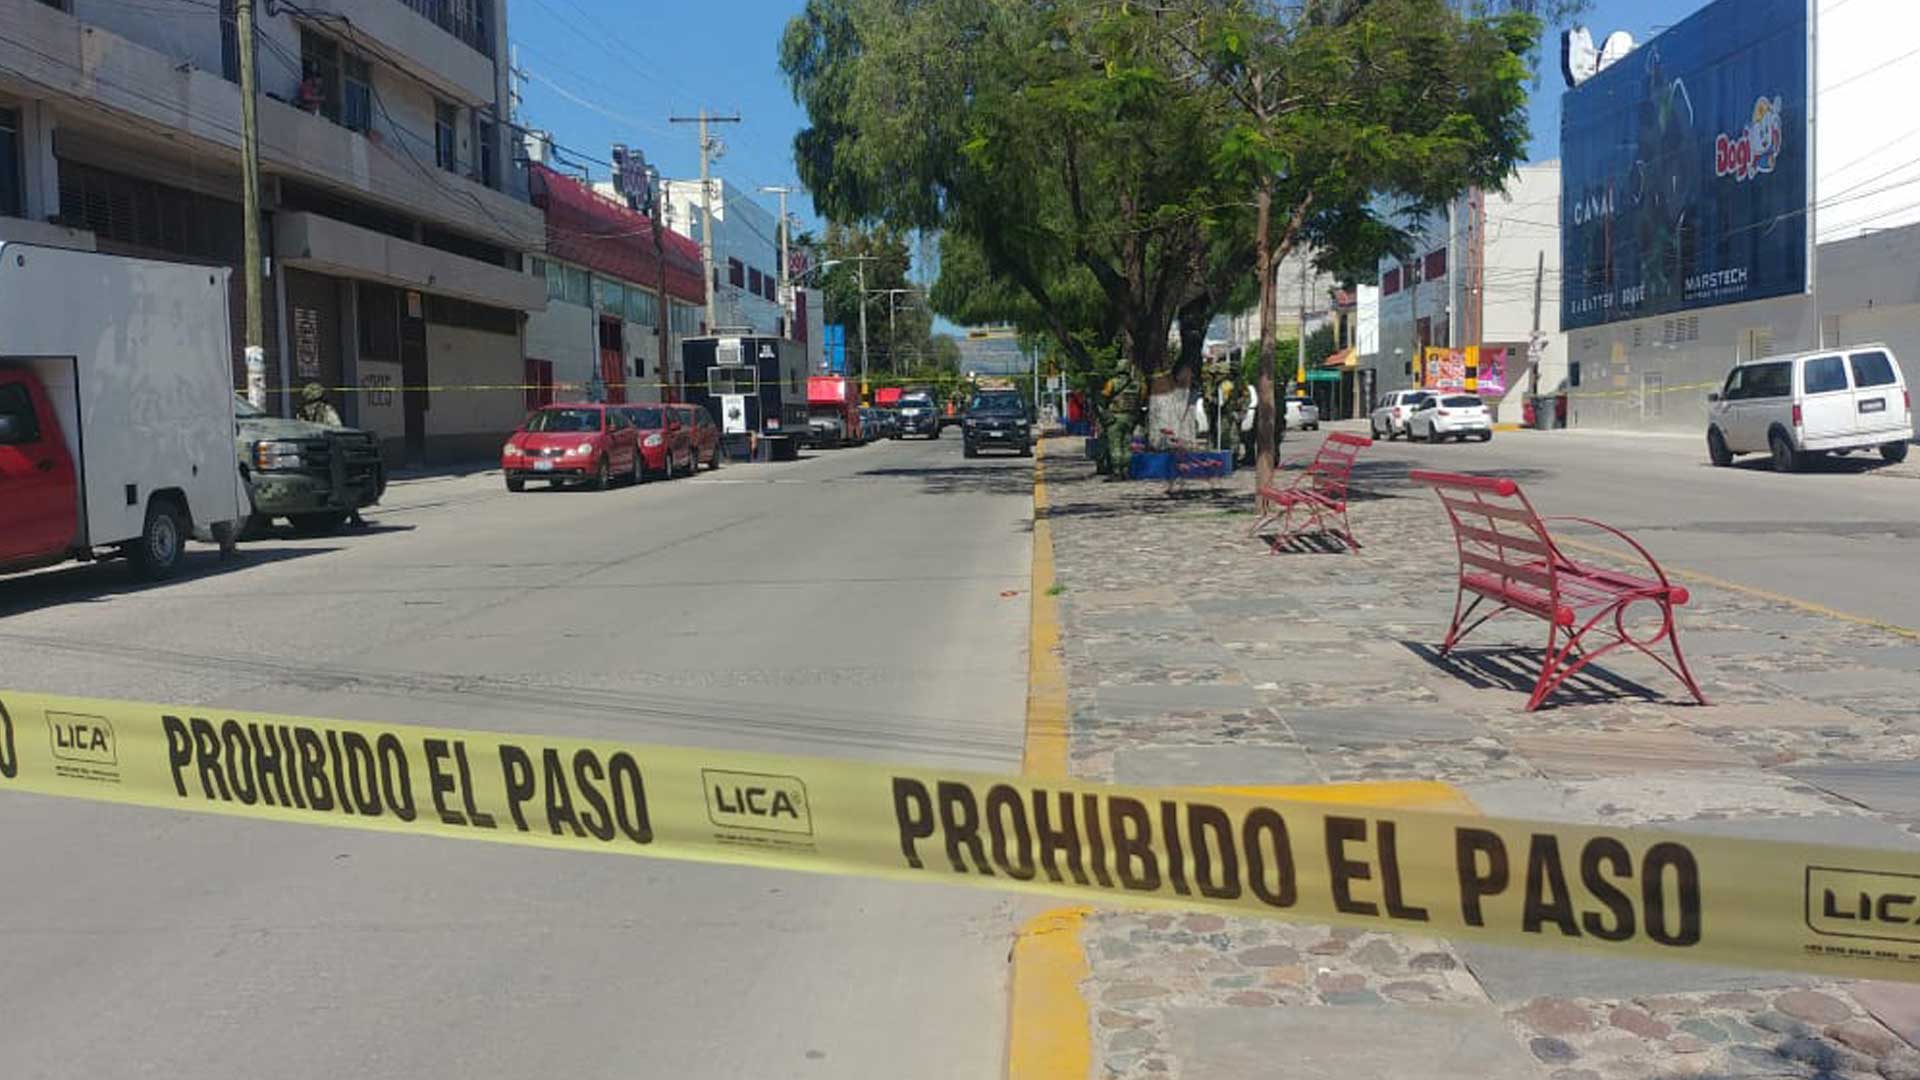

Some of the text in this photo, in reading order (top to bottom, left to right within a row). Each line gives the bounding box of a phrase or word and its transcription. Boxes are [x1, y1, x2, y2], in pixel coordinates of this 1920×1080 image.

[1684, 267, 1748, 290] MARSTECH
[162, 715, 653, 844] PROHIBIDO EL PASO
[892, 777, 1701, 947] PROHIBIDO EL PASO
[1823, 888, 1920, 925] LIC
